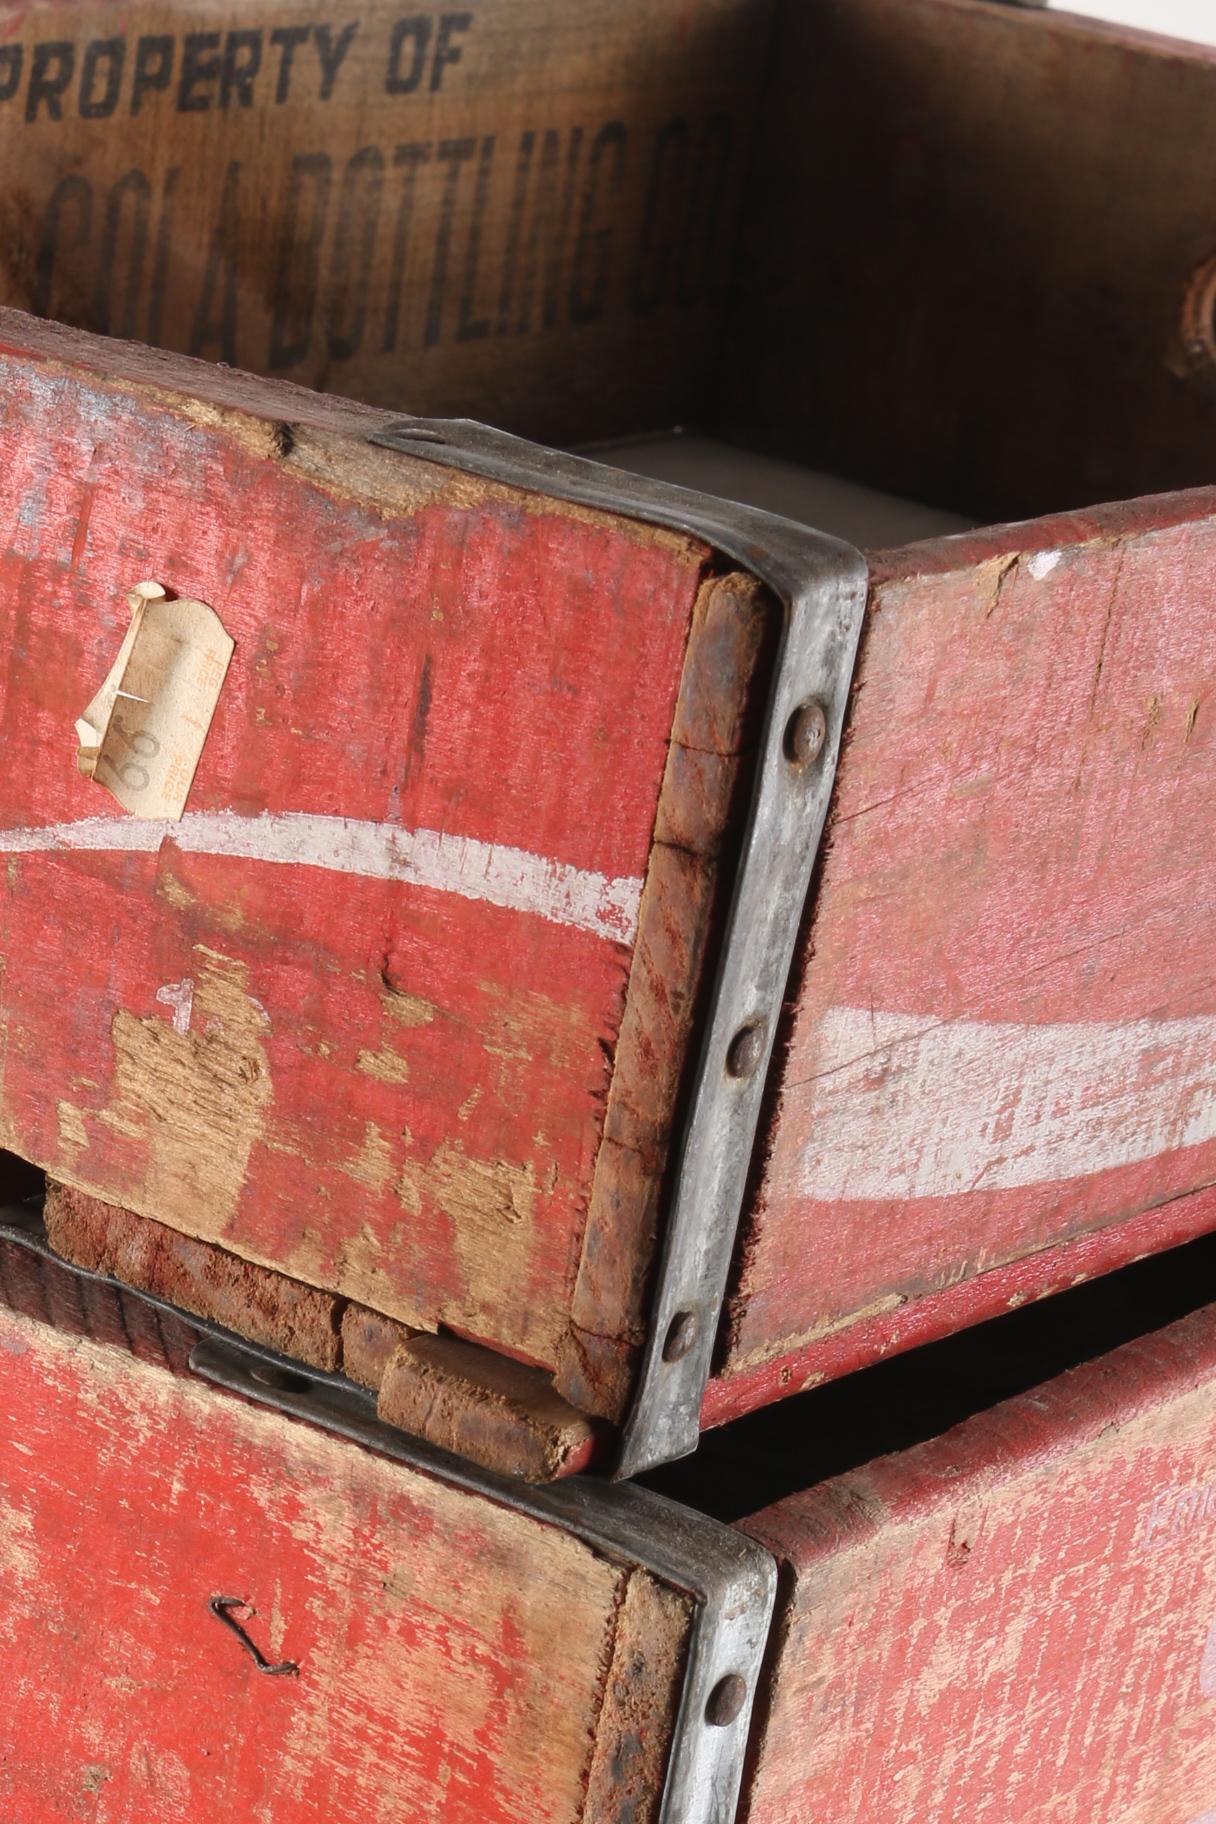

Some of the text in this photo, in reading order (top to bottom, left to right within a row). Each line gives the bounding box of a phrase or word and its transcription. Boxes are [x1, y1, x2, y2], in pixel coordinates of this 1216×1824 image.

[383, 12, 473, 96] OF
[267, 120, 629, 370] BOTTLING
[161, 753, 182, 801] PRICE
